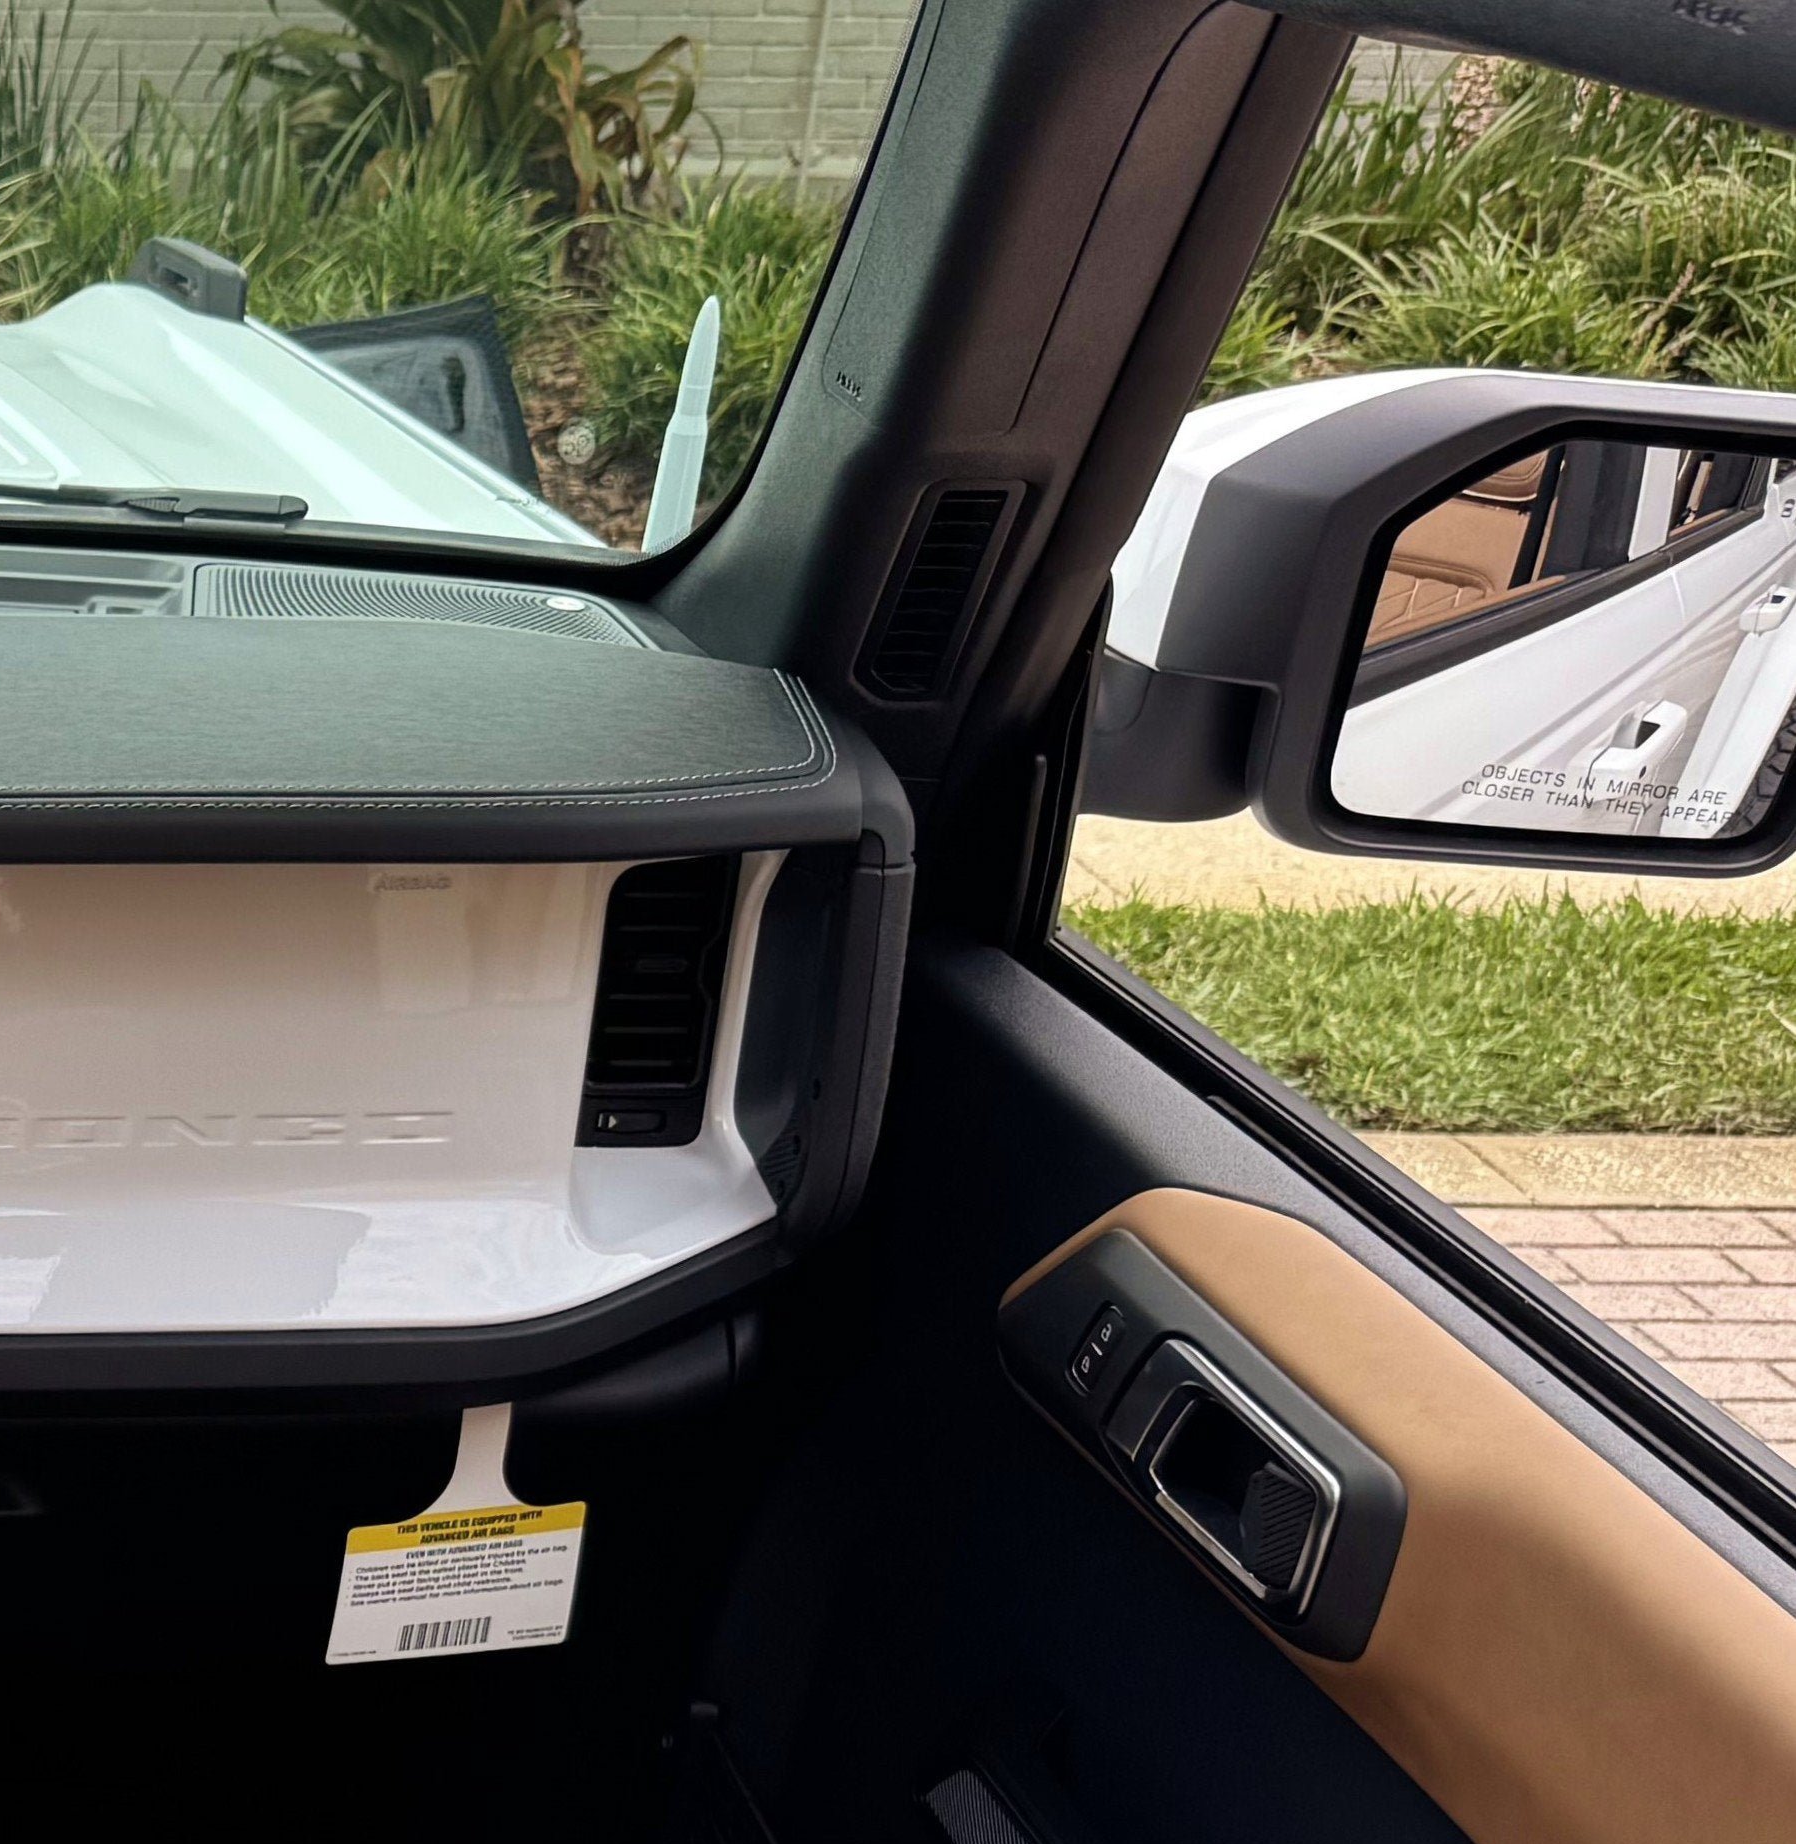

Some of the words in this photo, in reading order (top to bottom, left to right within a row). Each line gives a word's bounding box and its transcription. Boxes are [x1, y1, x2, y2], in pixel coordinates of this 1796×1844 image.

[1461, 780, 1534, 801] CLOSER
[1545, 791, 1594, 809] THAN
[1606, 797, 1653, 817] THEY
[1481, 764, 1566, 788] OBJECTS
[1577, 777, 1596, 791] IN
[1606, 780, 1679, 800] MIRROR
[1688, 789, 1727, 805] ARE
